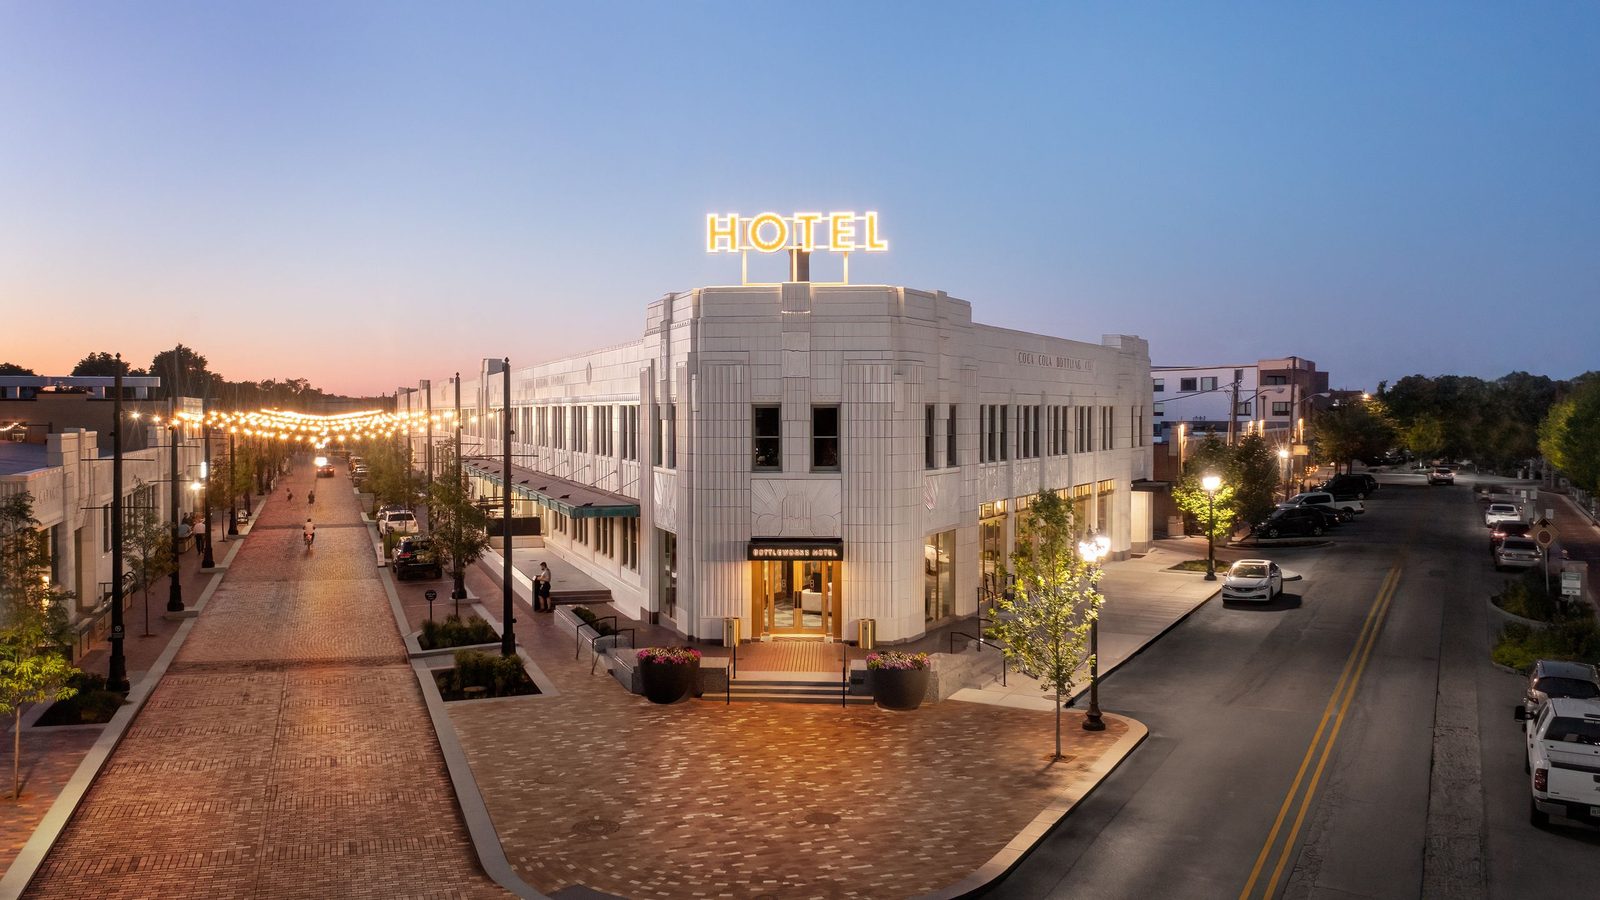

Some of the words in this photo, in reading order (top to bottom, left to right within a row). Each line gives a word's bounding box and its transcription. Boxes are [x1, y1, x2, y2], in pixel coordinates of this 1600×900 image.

[706, 211, 889, 253] HOTEL
[1018, 351, 1034, 365] COCA
[1038, 354, 1053, 367] COLA
[1056, 356, 1081, 370] BOTTLING
[752, 548, 810, 557] BOTTLEWORKS
[811, 548, 838, 557] HOTEL
